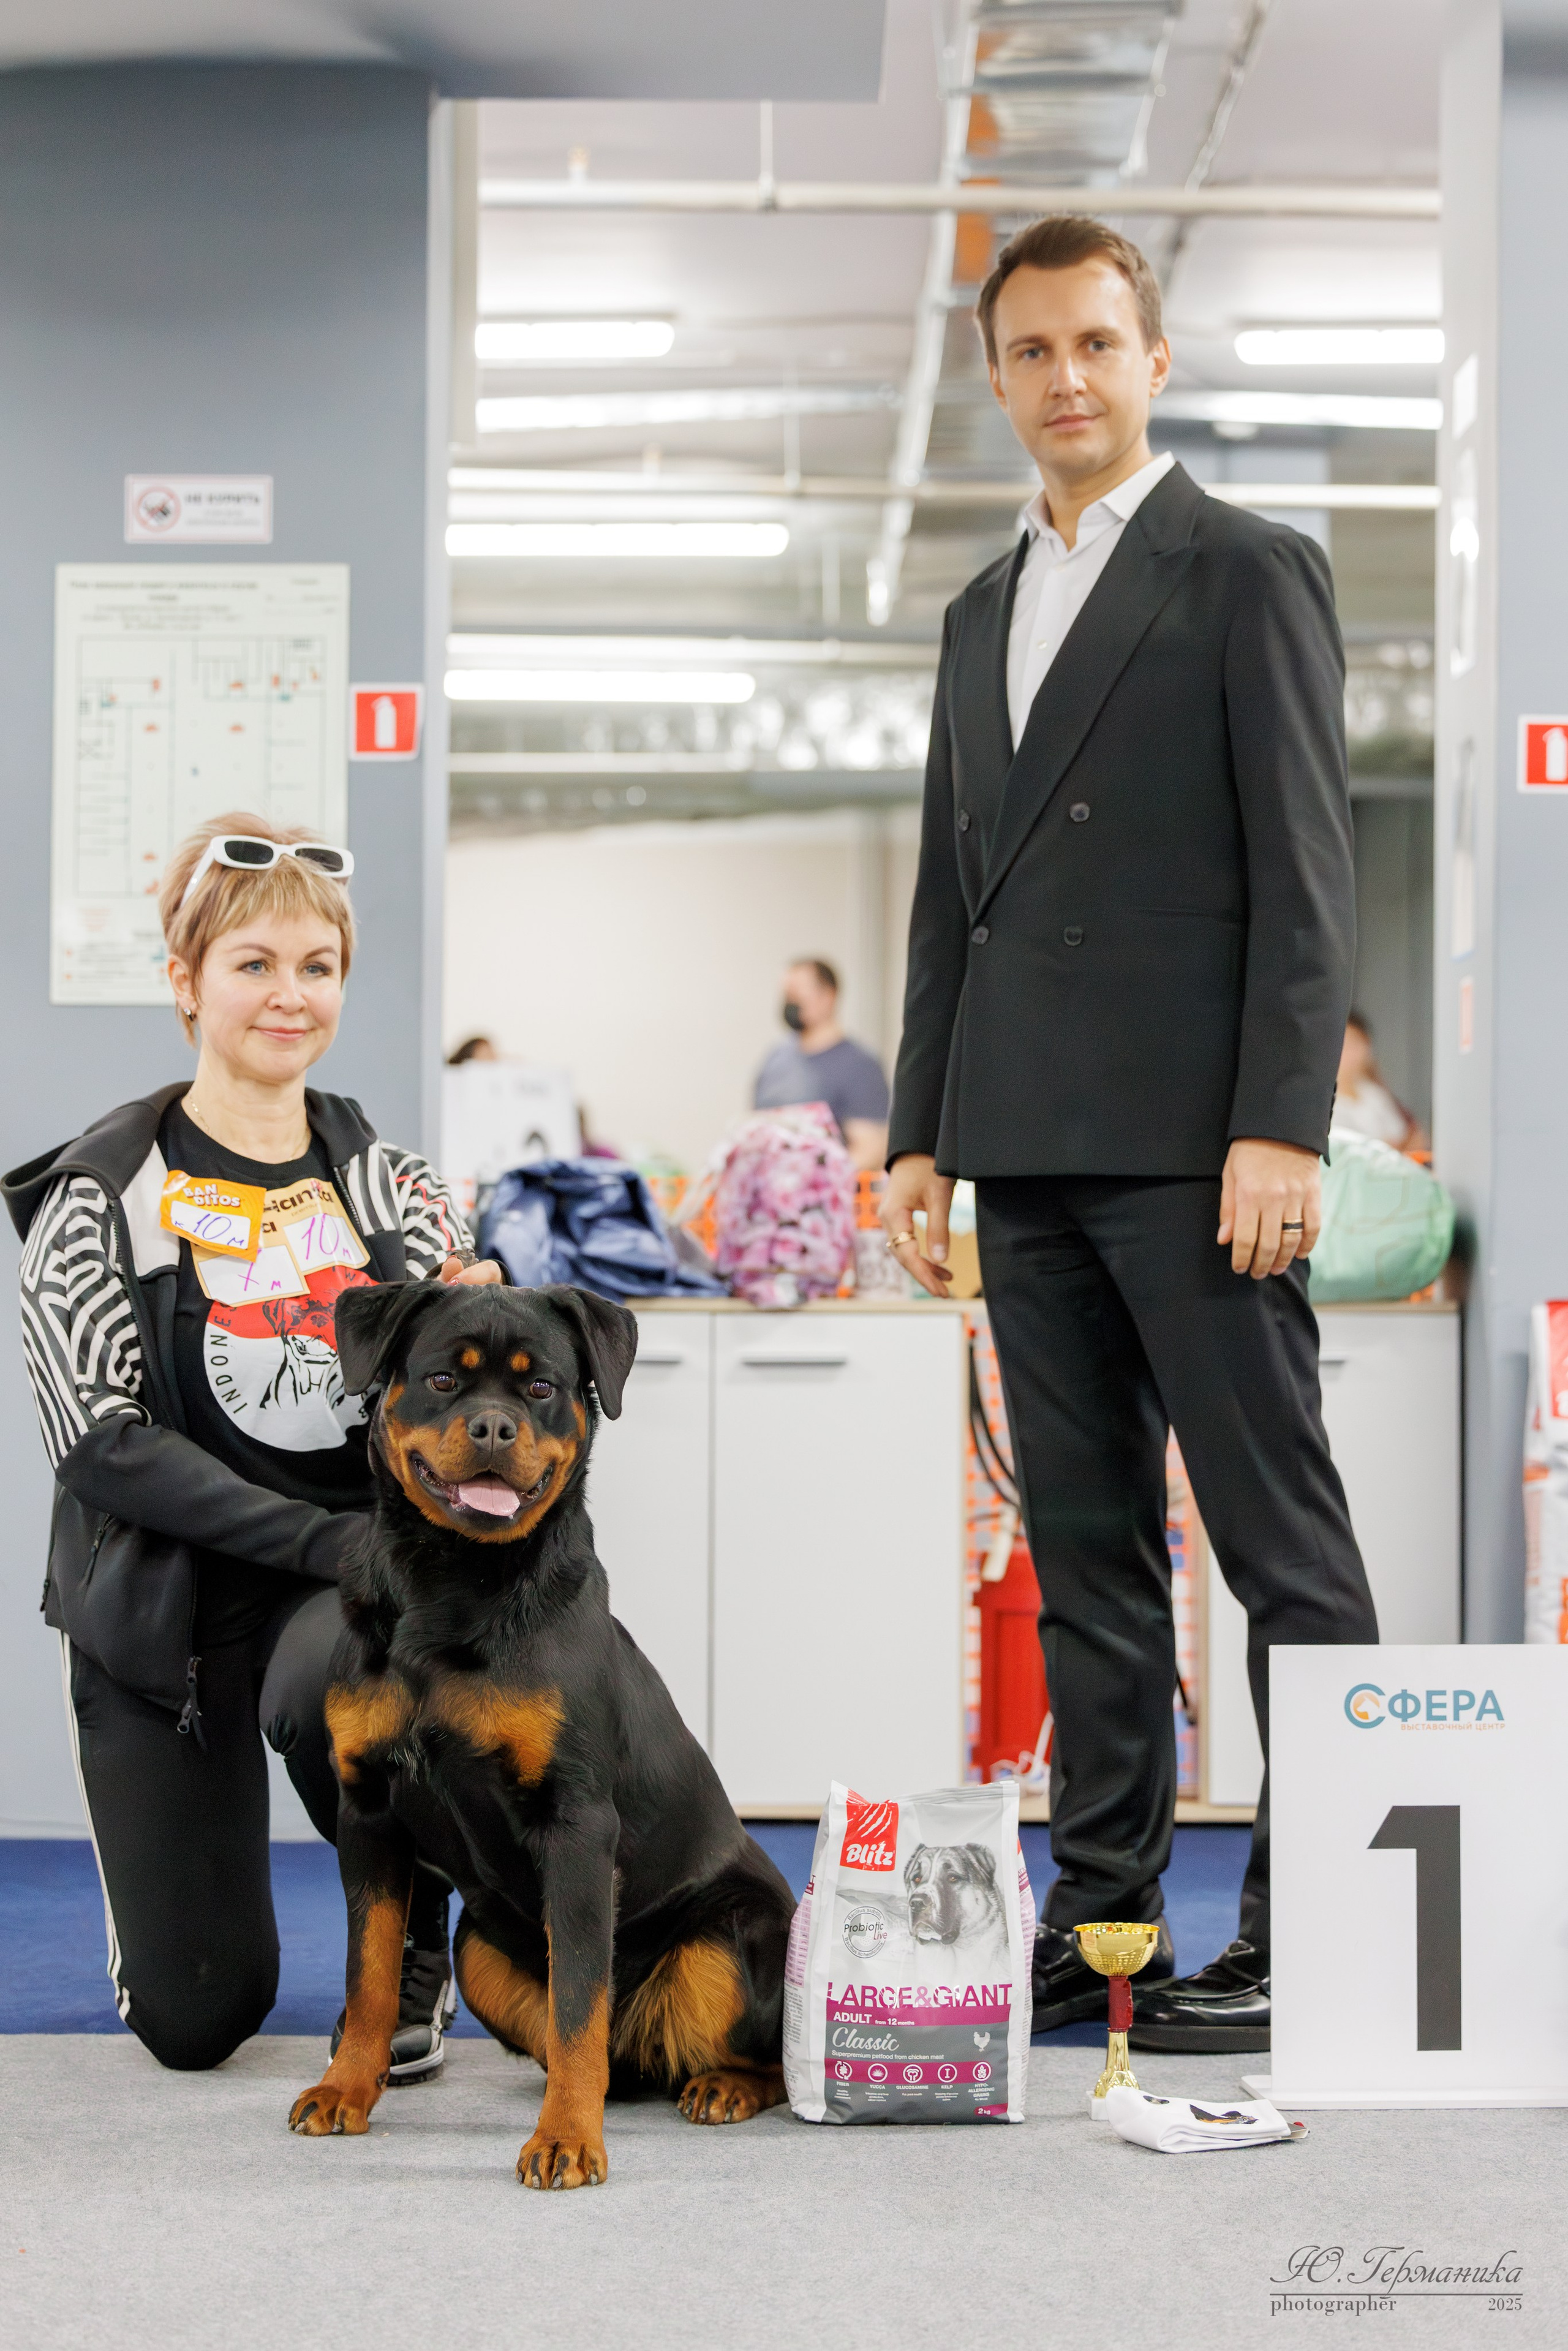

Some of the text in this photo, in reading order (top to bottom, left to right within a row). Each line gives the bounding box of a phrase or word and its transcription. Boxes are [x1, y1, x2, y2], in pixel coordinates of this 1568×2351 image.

[183, 1183, 217, 1197] BAN
[193, 1194, 241, 1207] DITOS
[193, 1213, 232, 1240] 10
[301, 1213, 339, 1260] 10
[1344, 1683, 1505, 1729] СФЕРА
[1400, 1723, 1506, 1732] ВЫСТАВОЧНЫЙ ЦЕНТР
[846, 1841, 894, 1866] Blitz
[848, 1909, 865, 1920] Bacillus
[844, 1922, 884, 1933] Probiotic
[1366, 1805, 1462, 2051] 1
[873, 1929, 888, 1940] Live
[833, 2012, 873, 2024] ADULT
[832, 2026, 900, 2051] Classic
[831, 2050, 871, 2058] Superpremium
